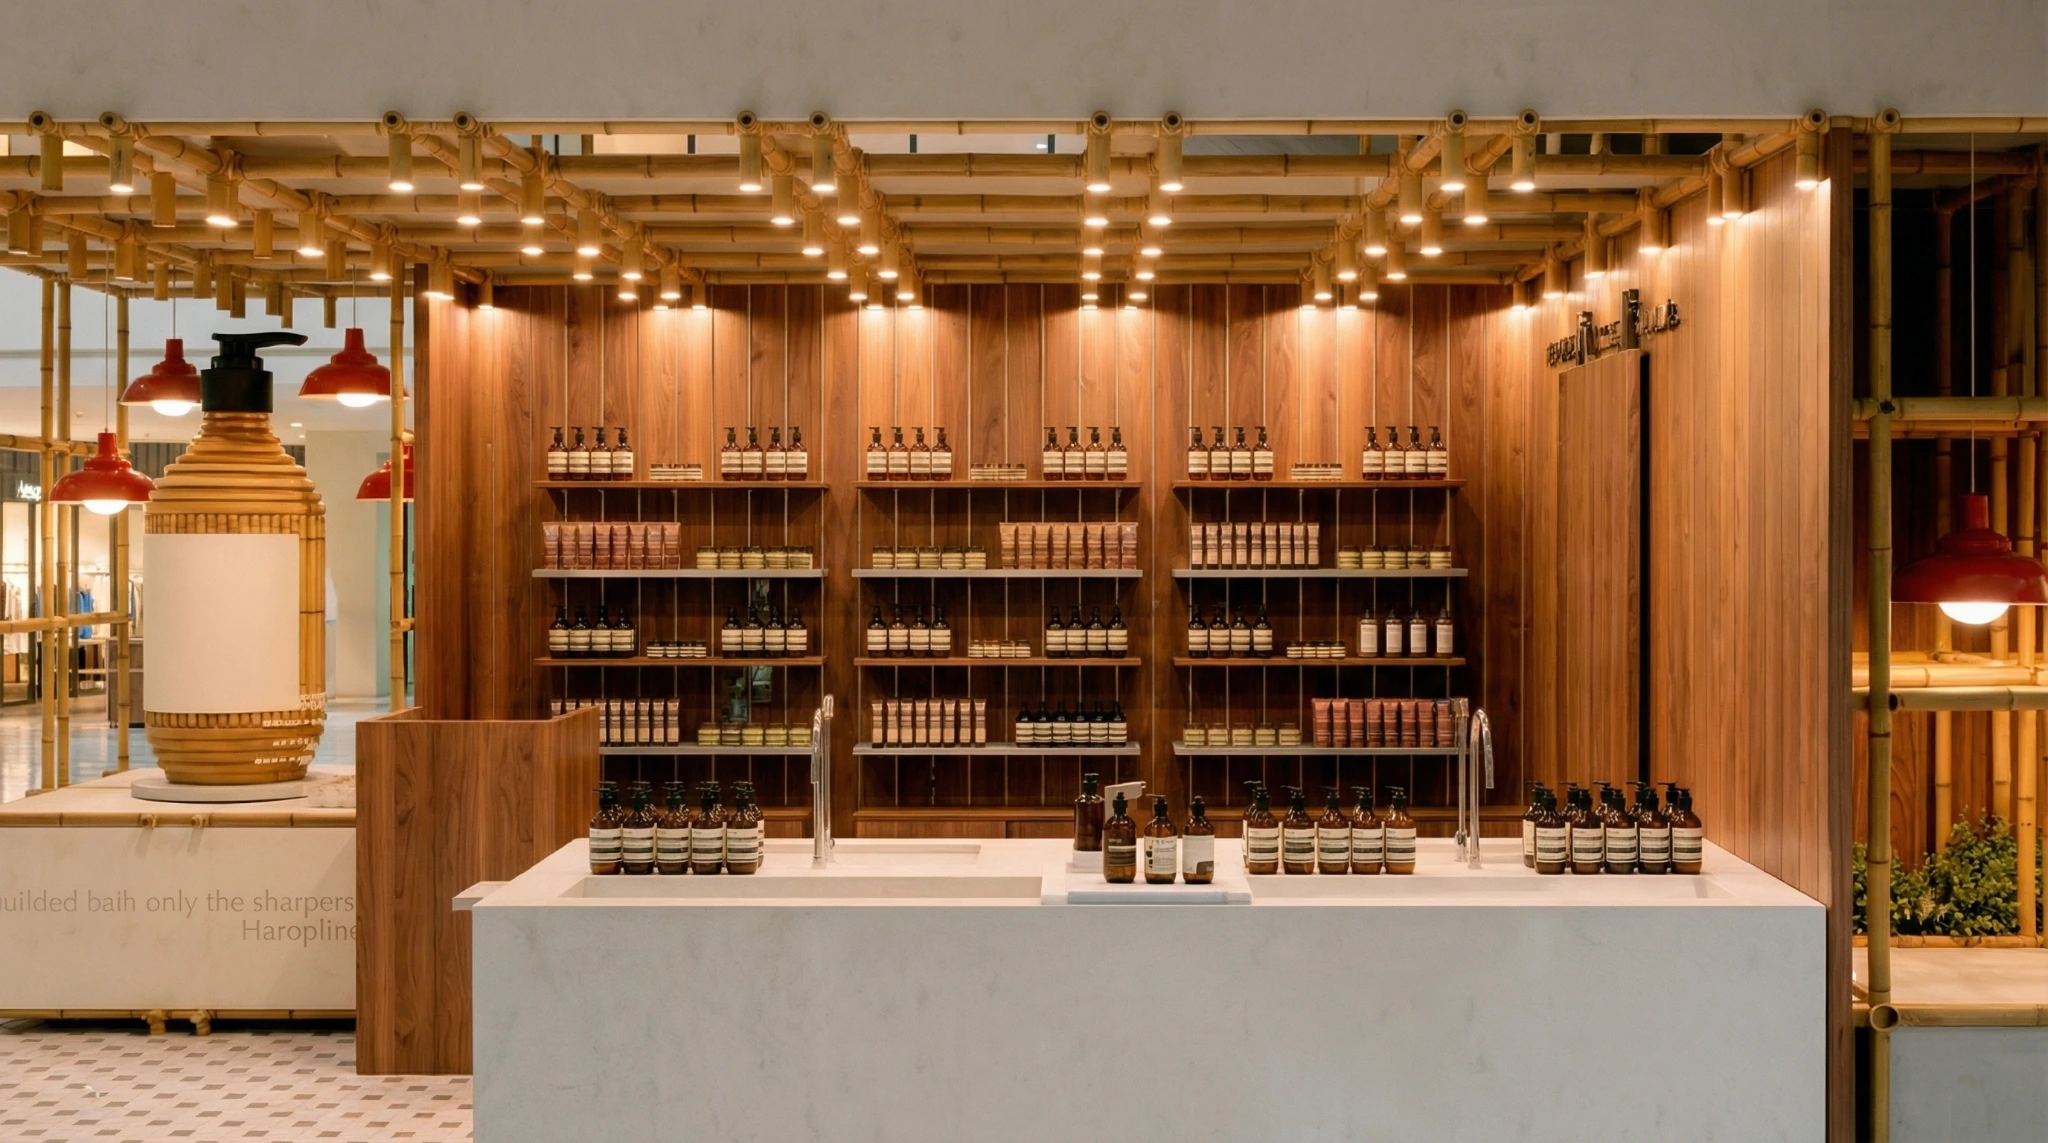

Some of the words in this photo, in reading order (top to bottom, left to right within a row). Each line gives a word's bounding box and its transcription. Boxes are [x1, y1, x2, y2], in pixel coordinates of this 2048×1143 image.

[0, 889, 77, 912] uilded
[146, 889, 198, 919] only
[205, 889, 244, 912] the
[253, 889, 354, 918] sharpers
